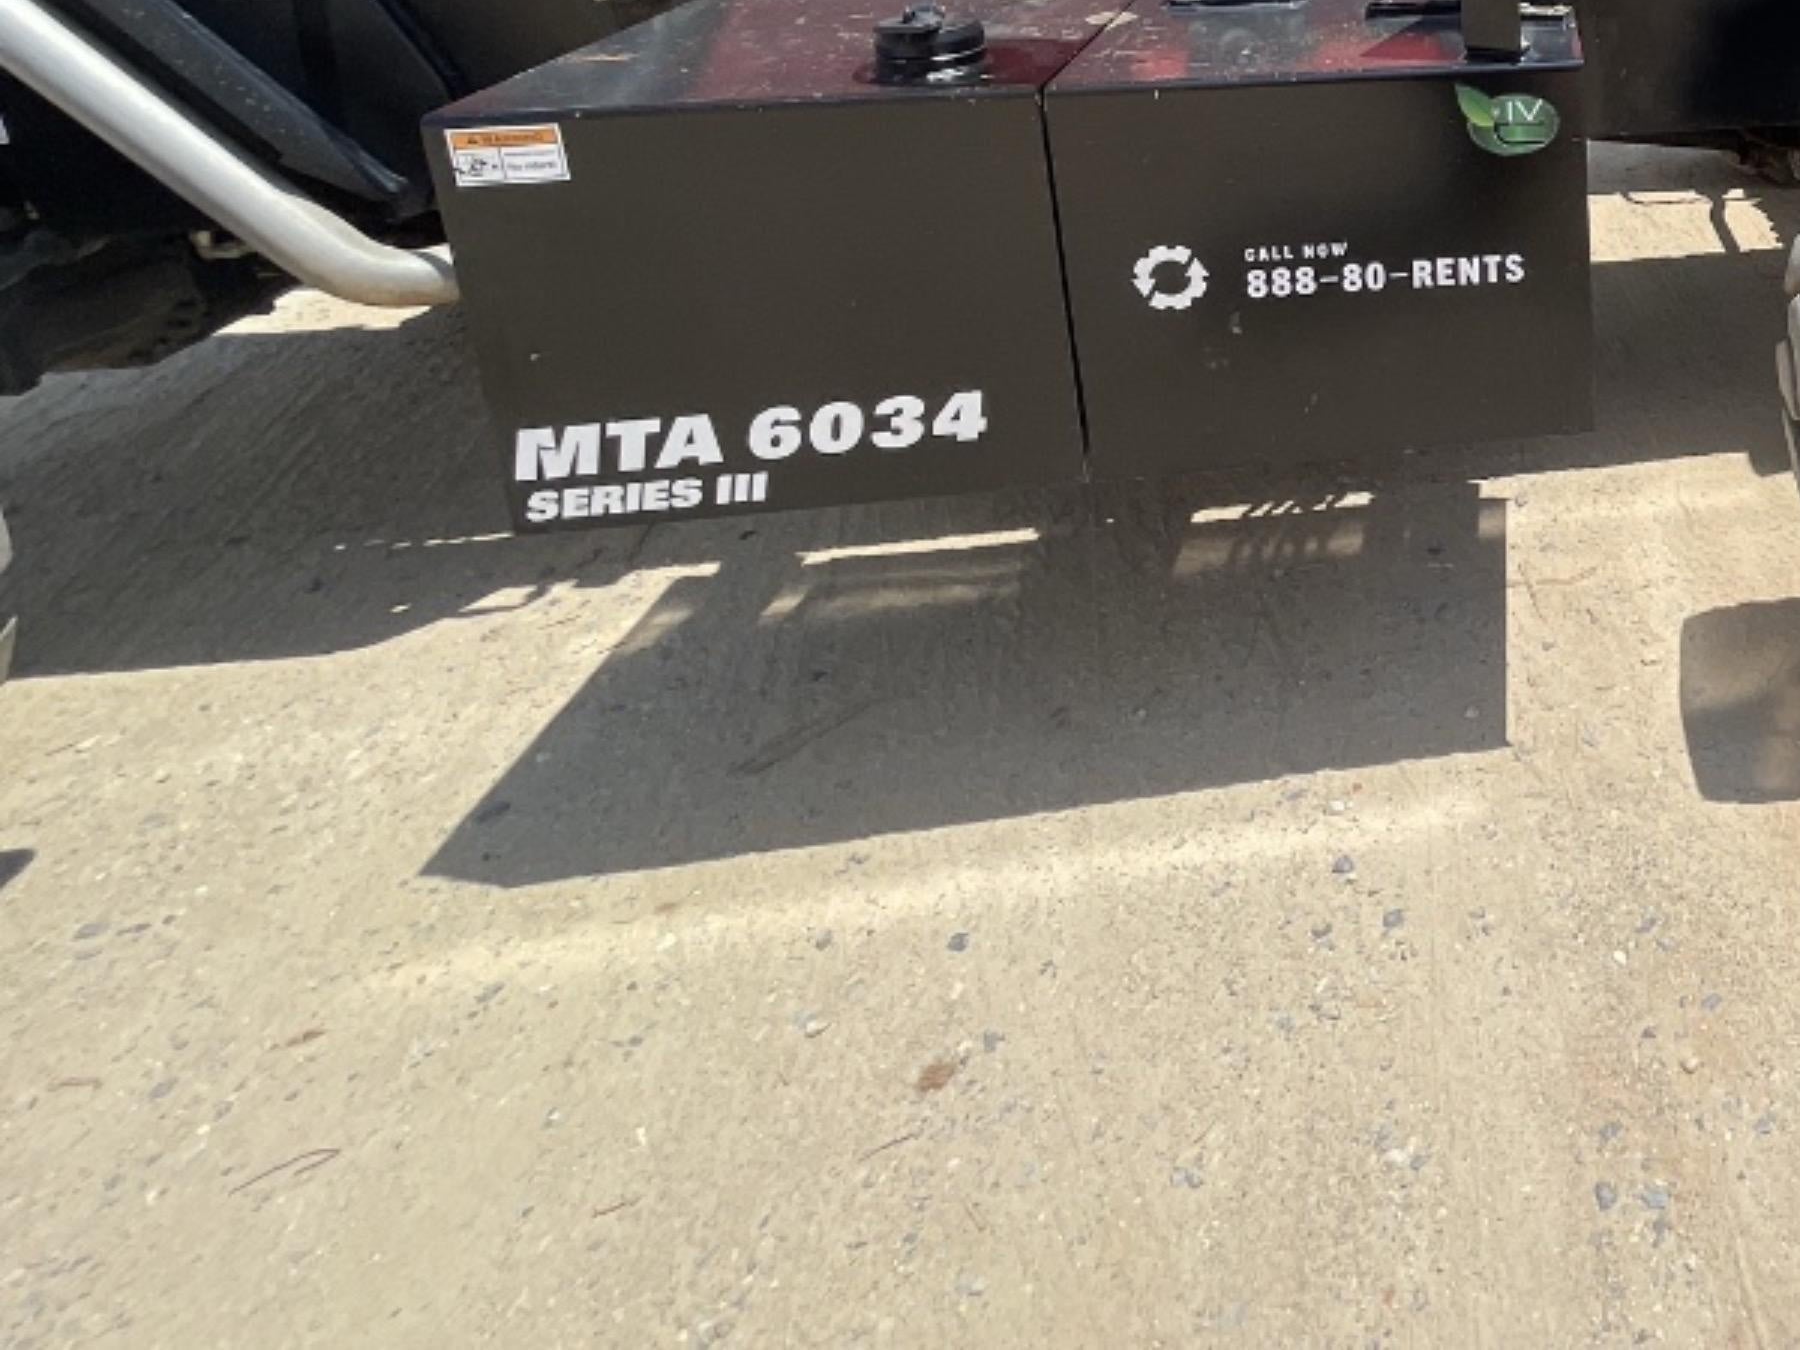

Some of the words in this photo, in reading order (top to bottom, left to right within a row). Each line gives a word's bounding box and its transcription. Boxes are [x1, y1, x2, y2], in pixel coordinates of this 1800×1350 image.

[1244, 245, 1294, 262] CALL
[1303, 241, 1348, 259] NOW
[1247, 254, 1525, 298] 888-80-RENTS
[515, 413, 724, 480] MTA
[748, 389, 988, 460] 6034
[525, 477, 703, 523] SERIES
[716, 470, 768, 505] III
